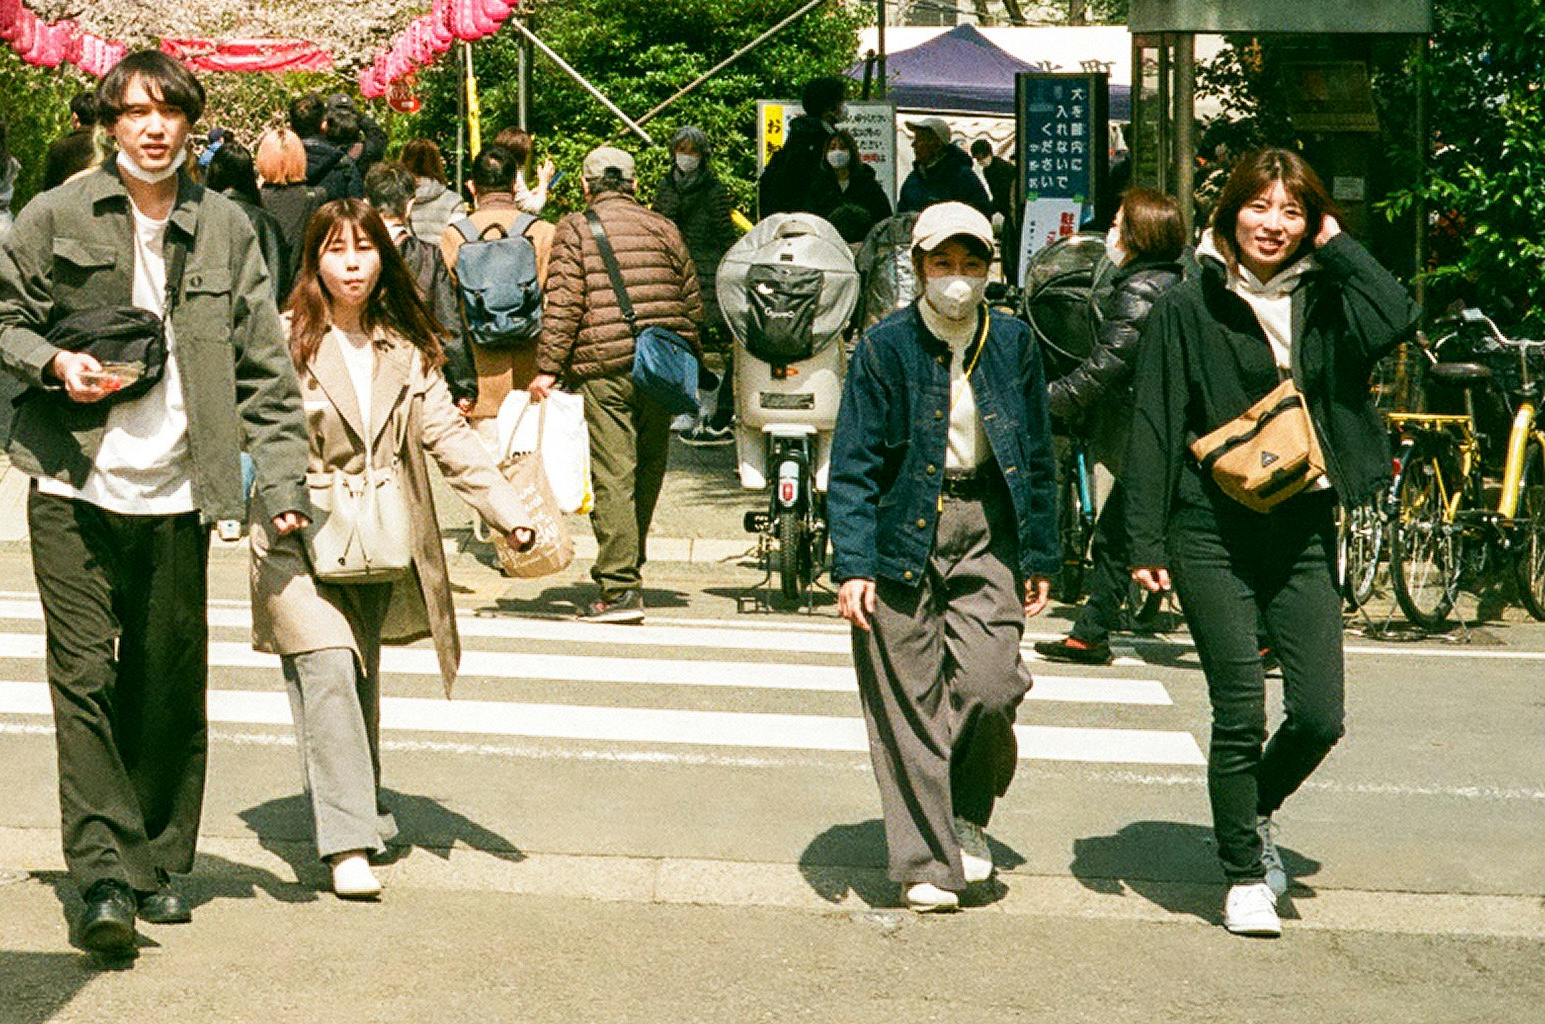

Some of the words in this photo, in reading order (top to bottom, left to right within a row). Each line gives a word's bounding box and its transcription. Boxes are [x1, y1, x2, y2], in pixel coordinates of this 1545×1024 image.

[1041, 123, 1054, 187] ください
[1056, 105, 1069, 189] 入れないで
